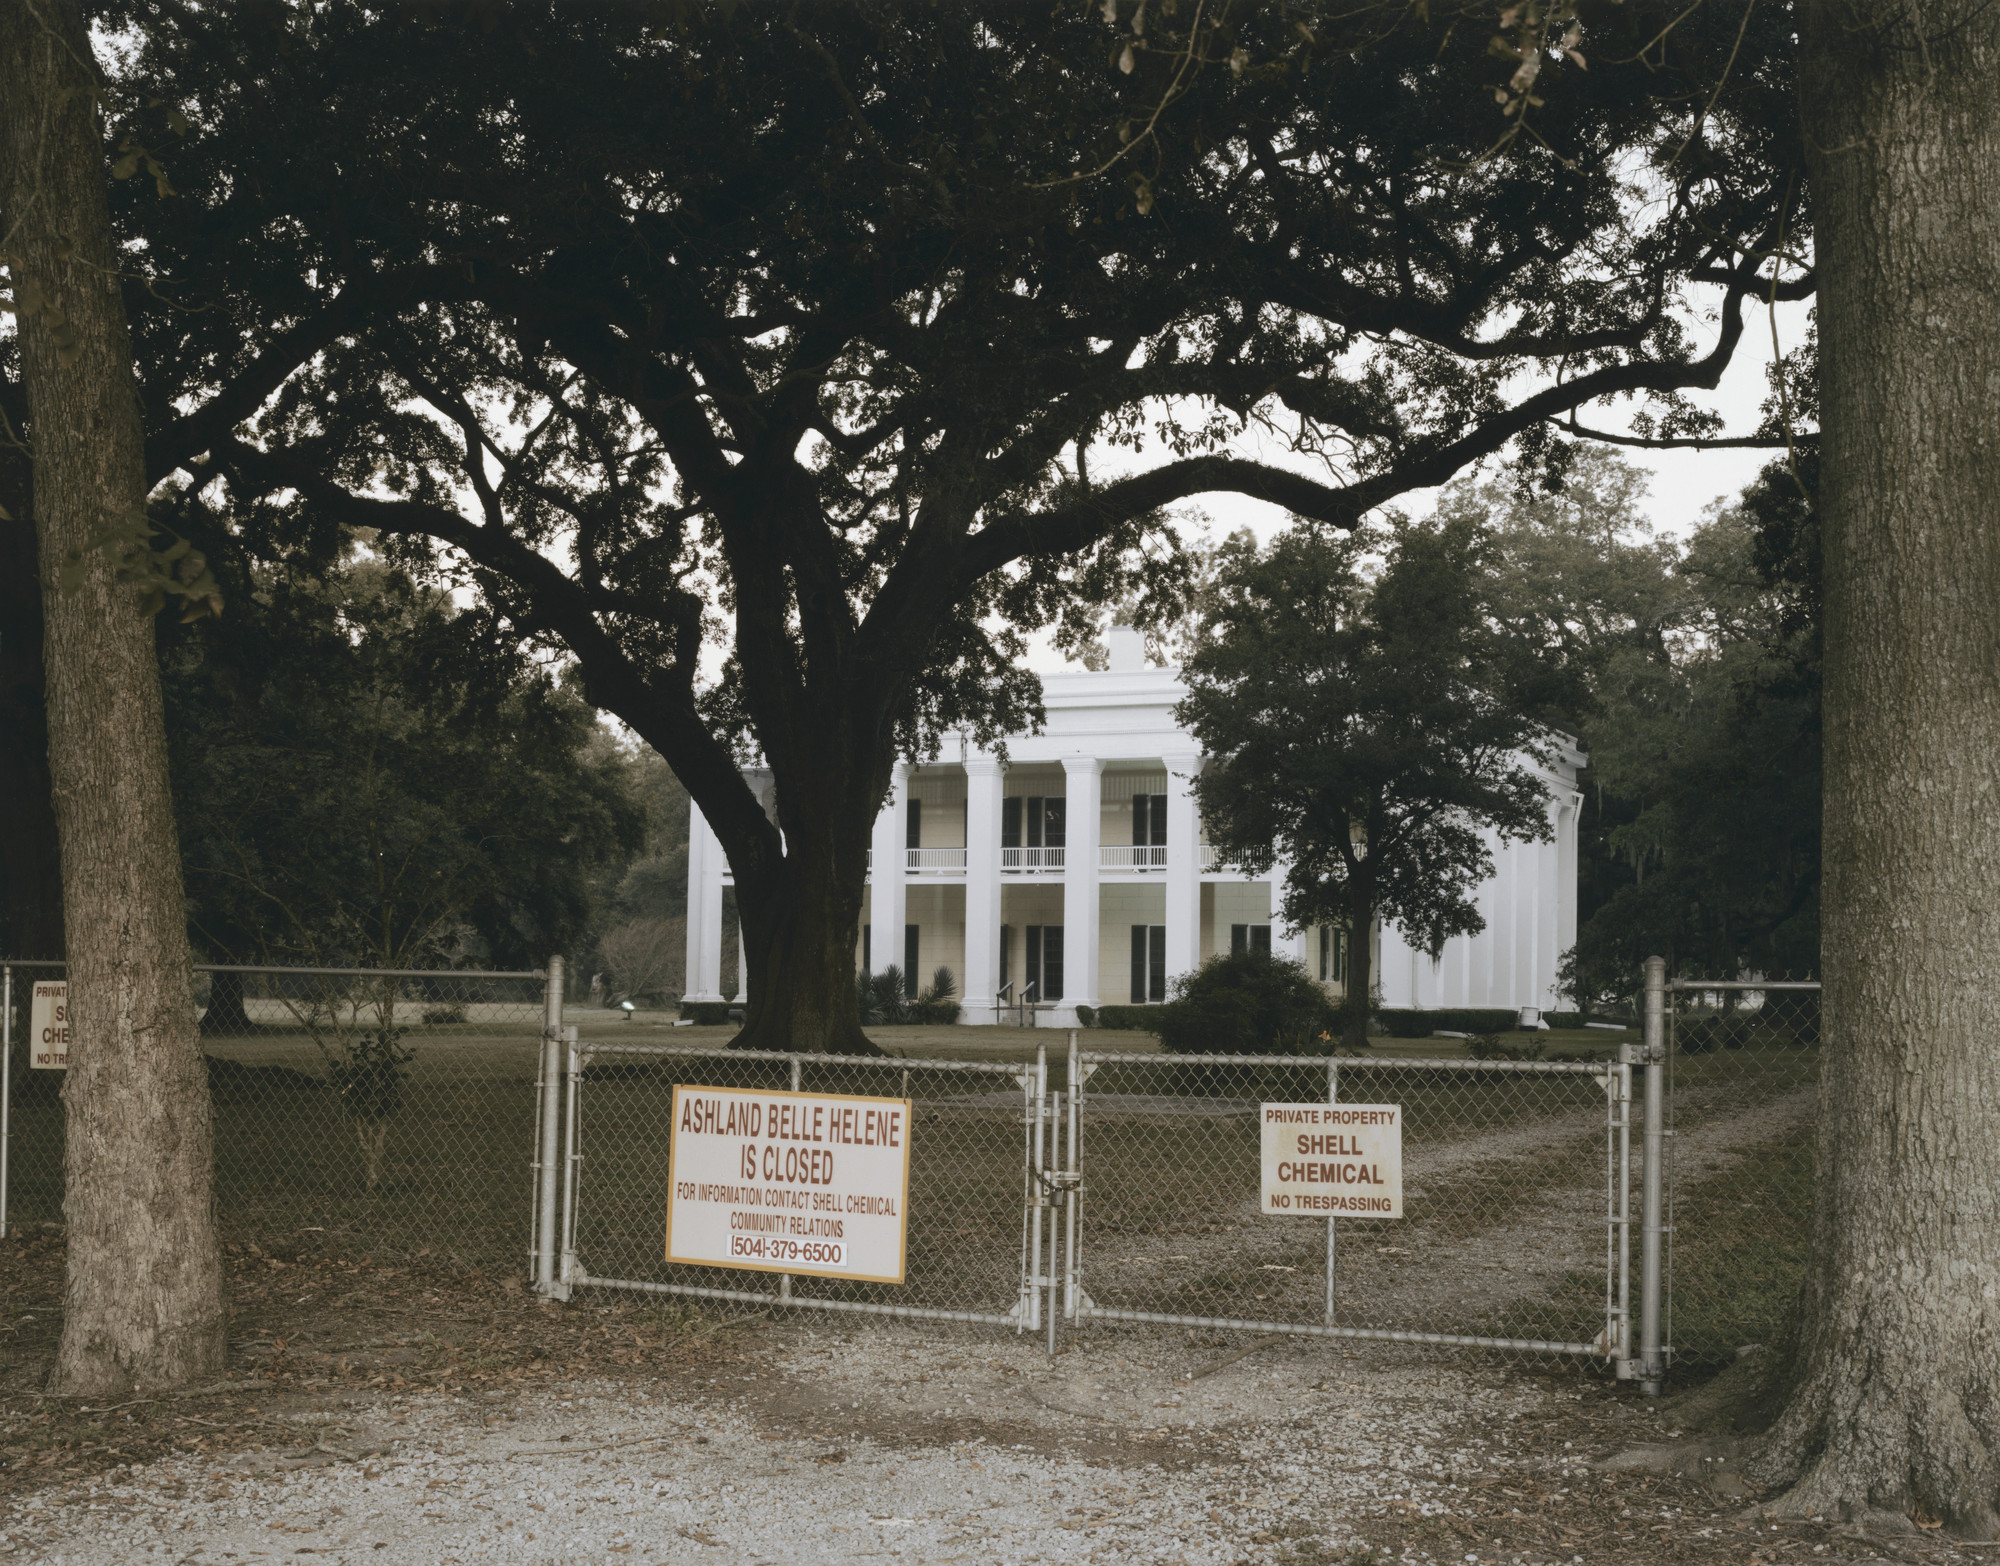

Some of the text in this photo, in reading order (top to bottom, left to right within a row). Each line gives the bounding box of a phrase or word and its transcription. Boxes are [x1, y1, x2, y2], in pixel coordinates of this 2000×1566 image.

[36, 987, 68, 997] PRIVAT
[37, 1054, 50, 1064] NO
[681, 1098, 900, 1147] ASHLAND BELLE HELENE
[1266, 1110, 1395, 1125] PRIVATE PROPERTY
[1297, 1134, 1363, 1155] SHELL
[741, 1144, 833, 1185] IS CLOSED
[1278, 1162, 1384, 1184] CHEMICAL
[678, 1182, 896, 1217] FOR INFORMATION CONTACT SHELL CHEMICAL
[1271, 1194, 1391, 1212] NO TRESPASSING
[730, 1211, 843, 1238] COMMUNITY RELATIONS
[731, 1235, 842, 1263] (504)-379-6500
